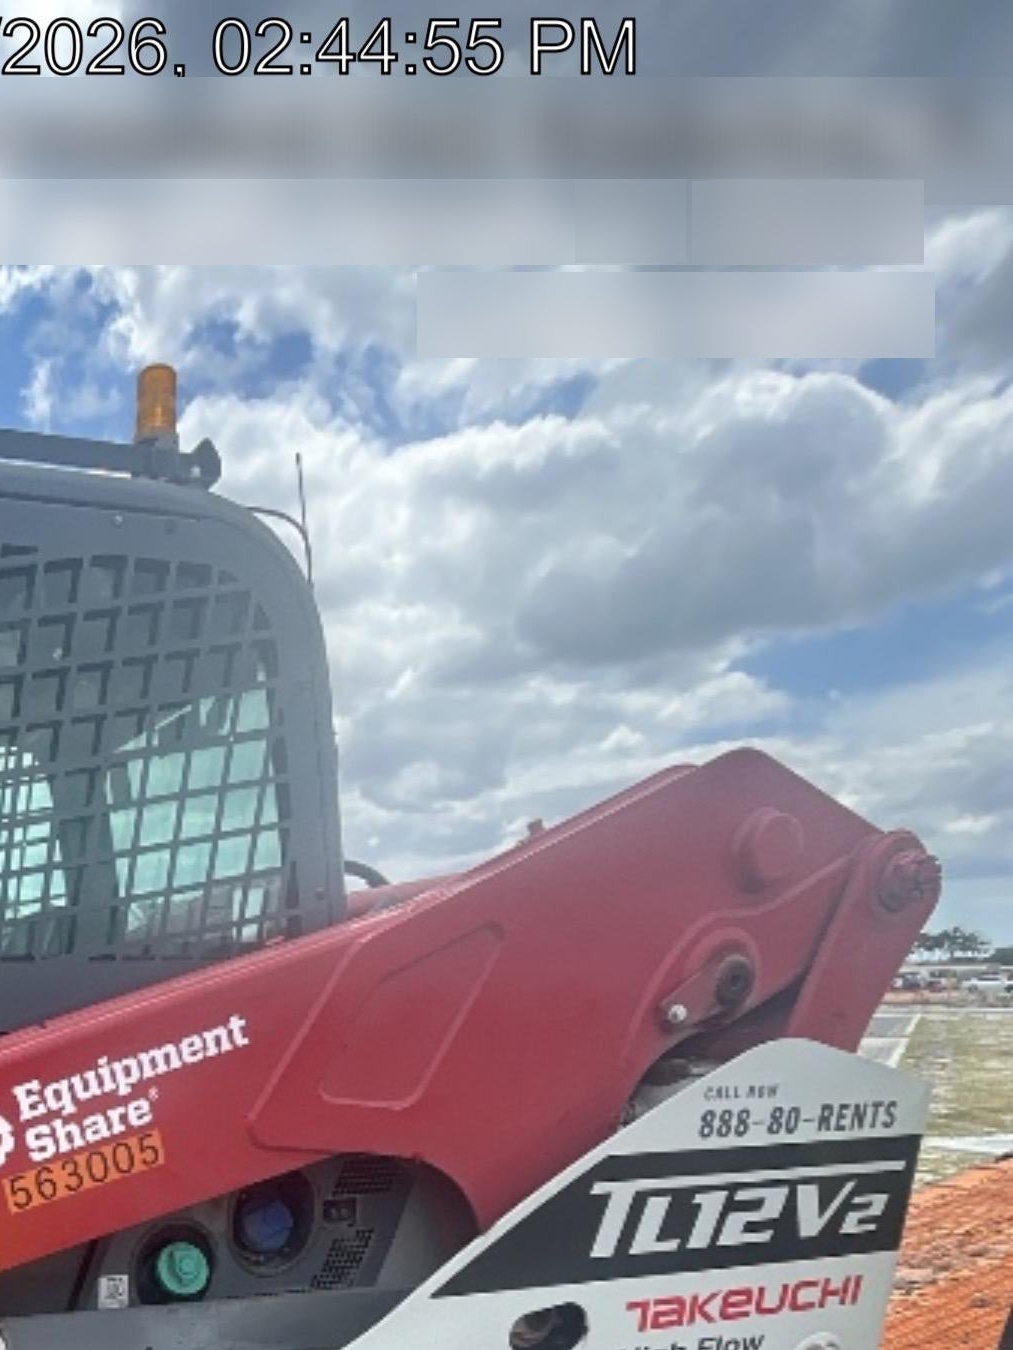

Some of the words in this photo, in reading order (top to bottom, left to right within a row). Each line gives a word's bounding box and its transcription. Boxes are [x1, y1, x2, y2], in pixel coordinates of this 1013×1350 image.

[12, 1015, 249, 1120] Equipment
[704, 1085, 740, 1101] CALL
[698, 1100, 898, 1138] 888-80-RENTS
[8, 1133, 162, 1210] 563005
